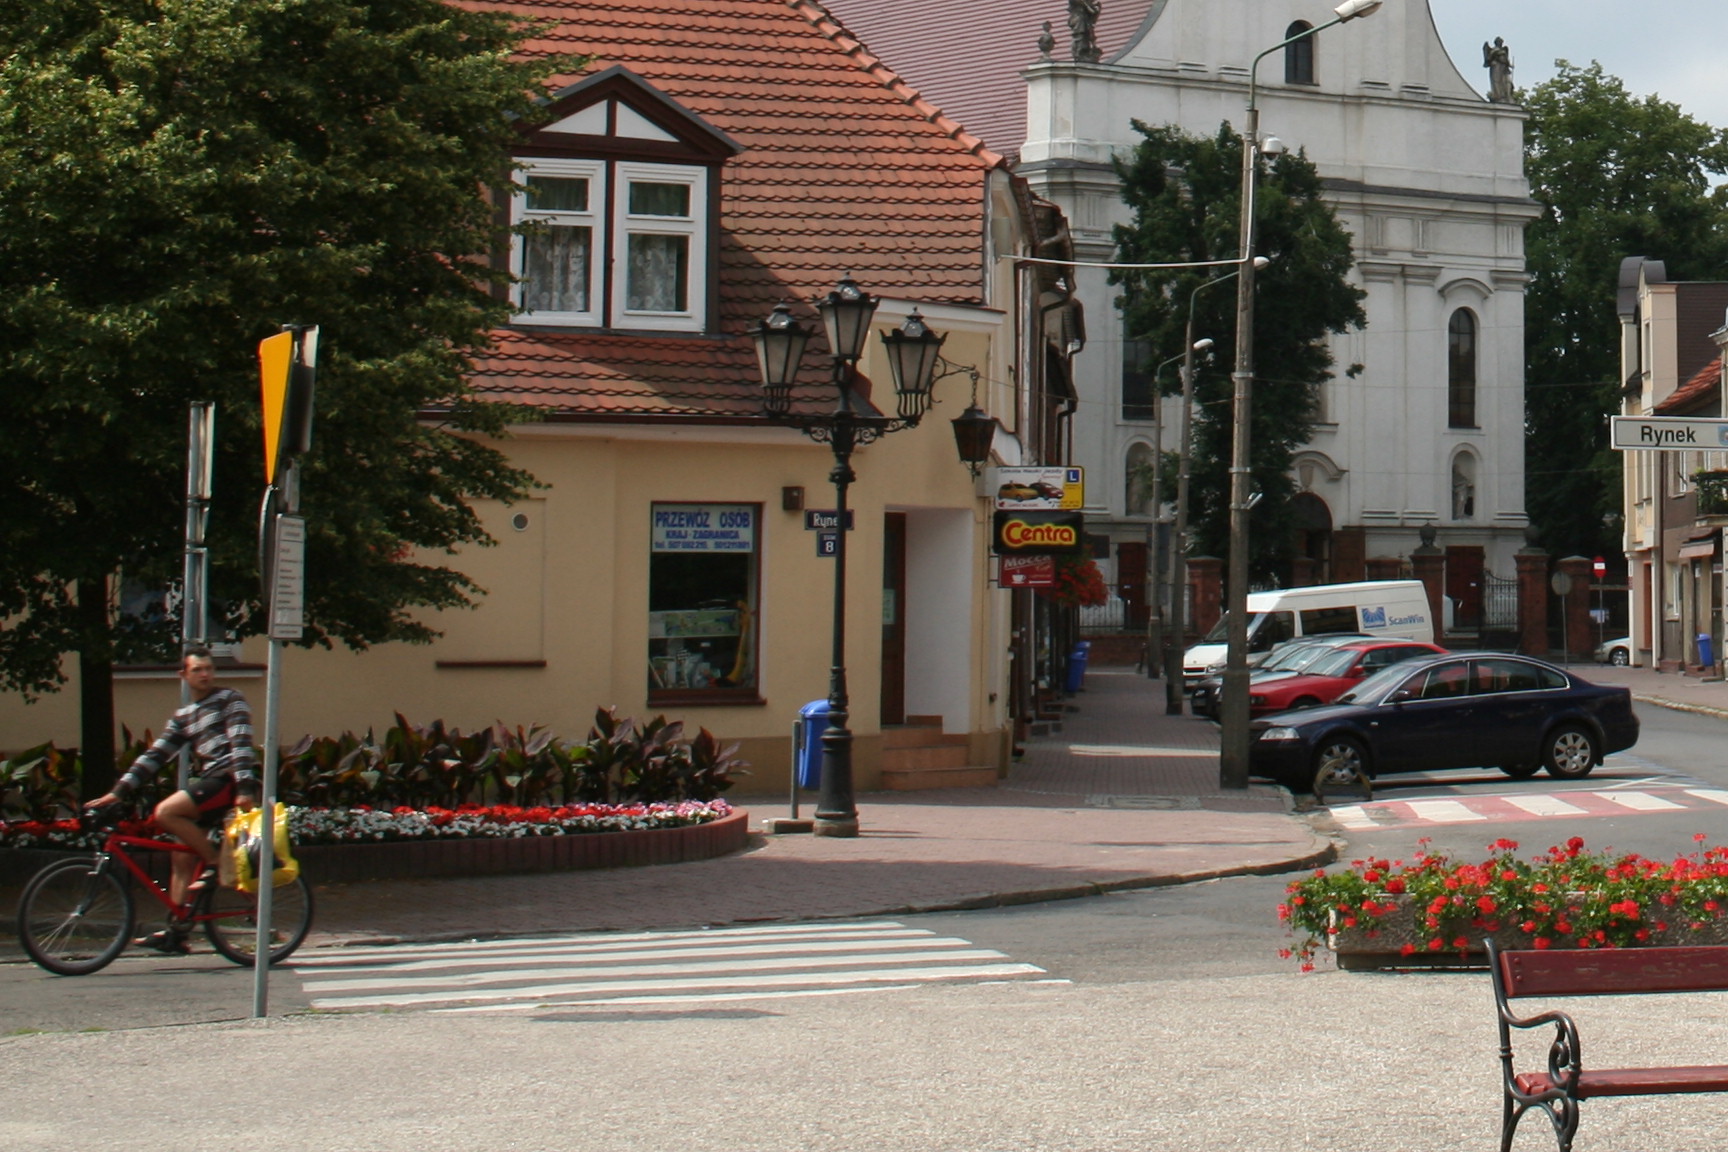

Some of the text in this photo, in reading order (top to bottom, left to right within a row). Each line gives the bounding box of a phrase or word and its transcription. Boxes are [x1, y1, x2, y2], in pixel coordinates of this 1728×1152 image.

[1640, 425, 1697, 447] Rynek
[1069, 471, 1077, 481] L
[655, 508, 750, 528] PRZEWÓZ OSÓB
[813, 512, 838, 529] Ryne
[1003, 520, 1075, 546] Centra
[825, 541, 834, 553] 8
[1388, 614, 1425, 626] ScanWin
